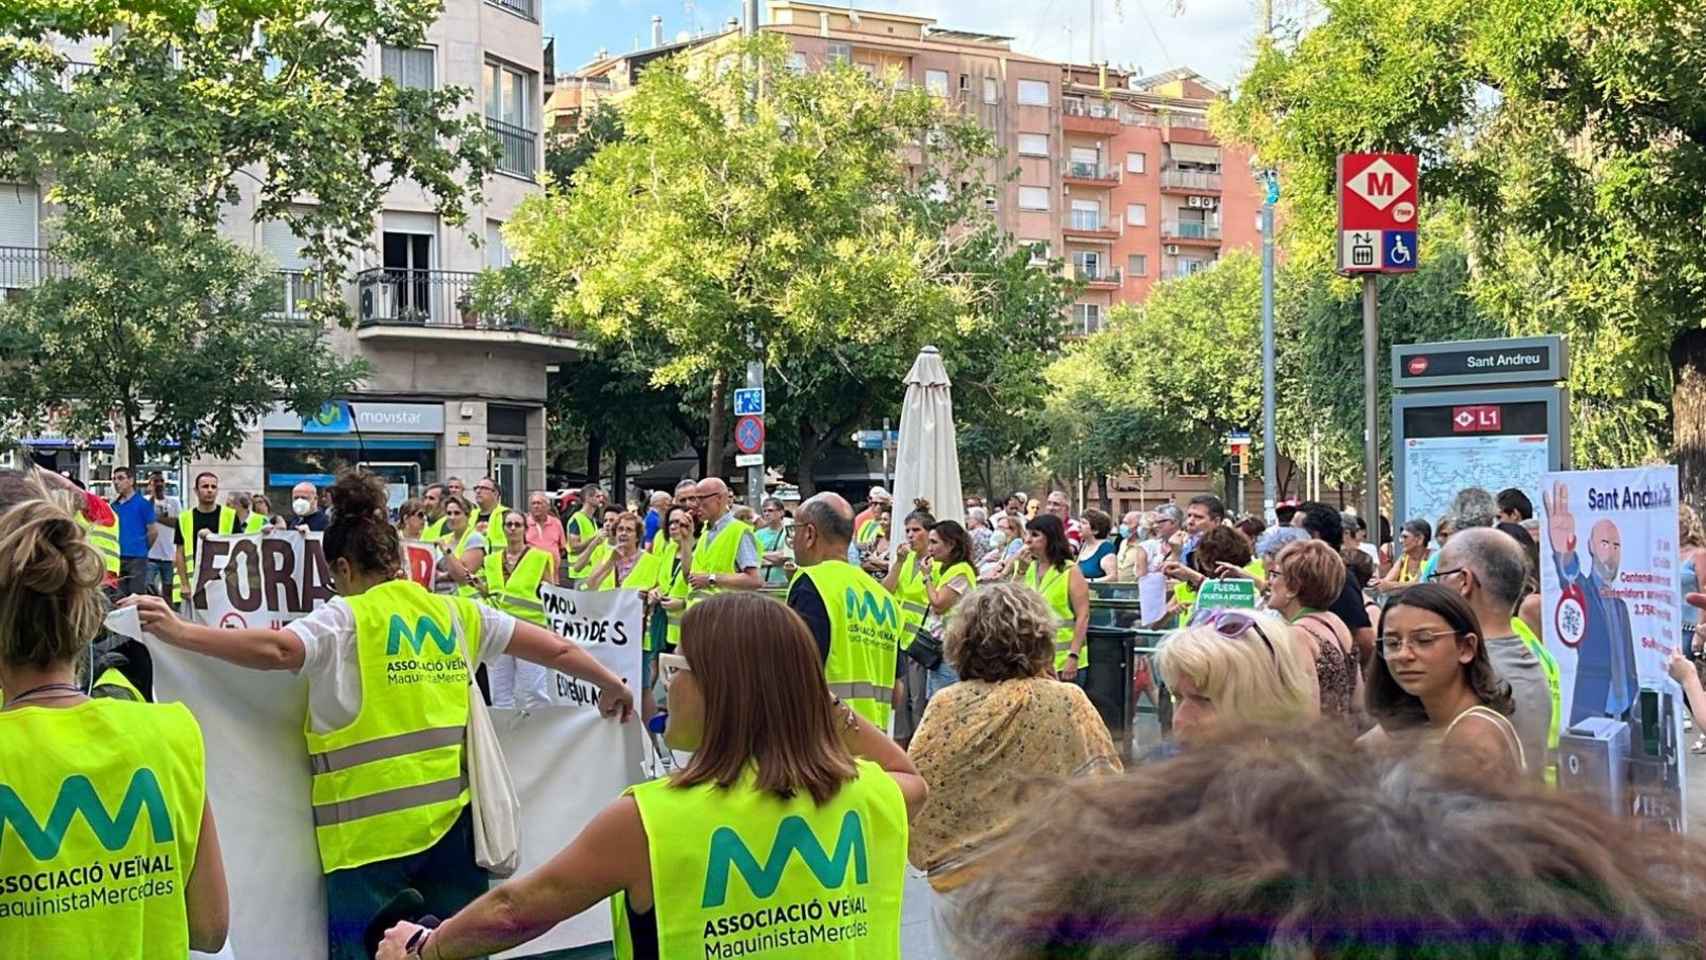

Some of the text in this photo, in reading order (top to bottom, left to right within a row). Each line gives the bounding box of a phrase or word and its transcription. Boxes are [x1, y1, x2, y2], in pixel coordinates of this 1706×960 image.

[1367, 173, 1393, 196] M
[1467, 353, 1540, 368] Sant Andreu
[360, 409, 421, 425] movistar
[1480, 410, 1497, 425] L1
[1588, 487, 1619, 511] Sant
[193, 539, 333, 612] FORA
[547, 617, 628, 646] ENTIDES
[387, 659, 444, 673] ASSOIACIÓ
[109, 855, 174, 880] VEÏNAL
[703, 898, 823, 939] ASSOCIACIÓ
